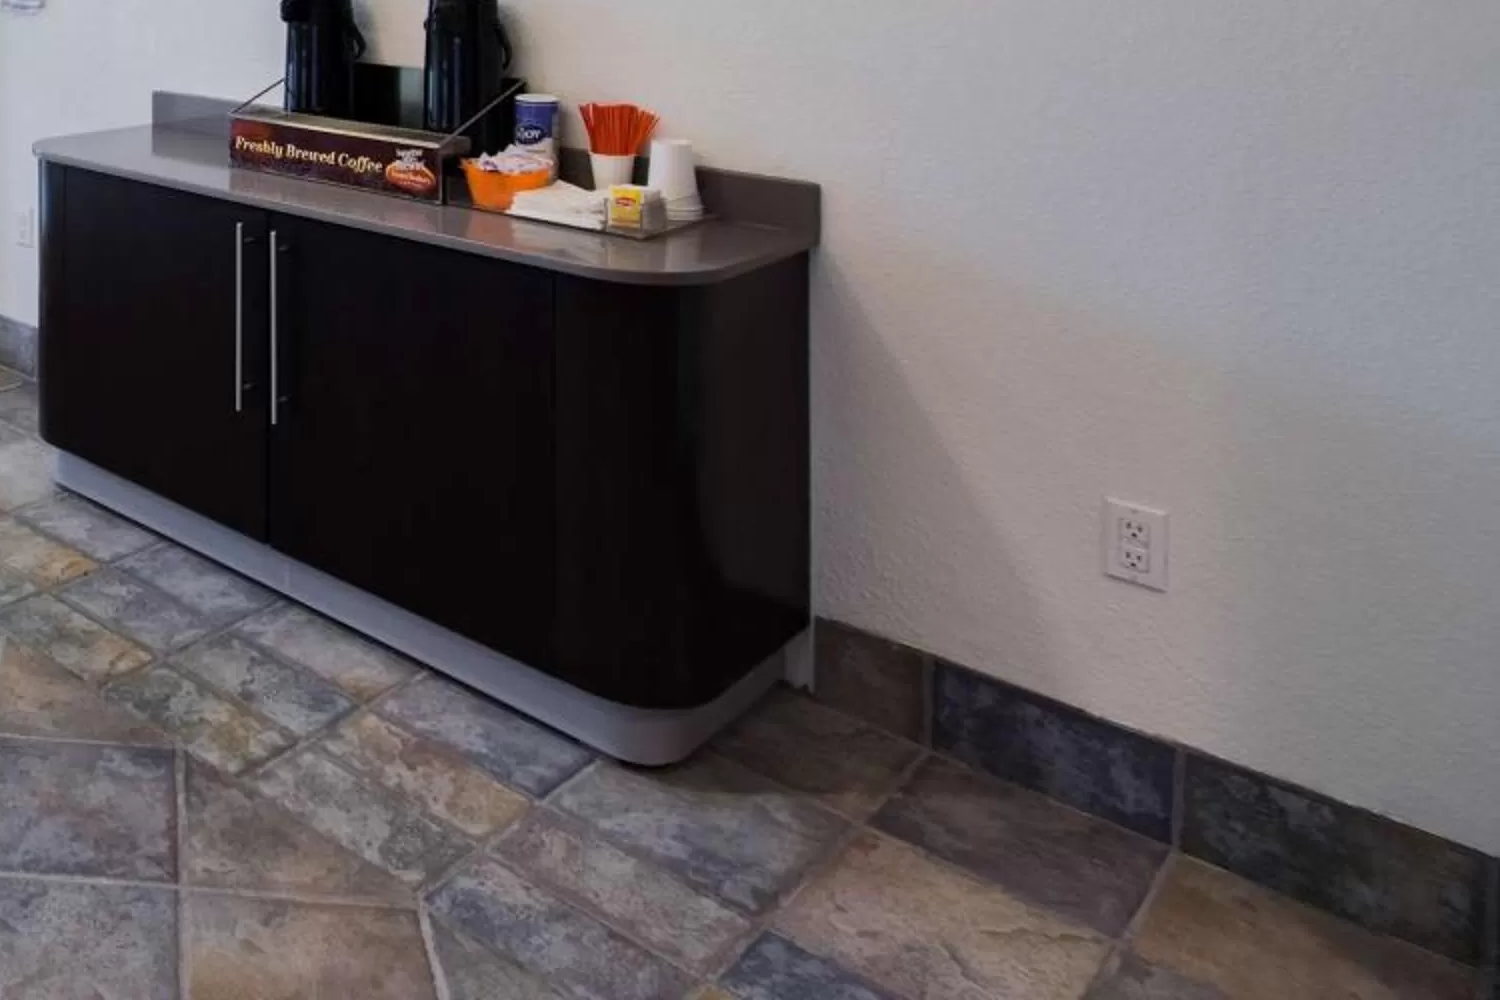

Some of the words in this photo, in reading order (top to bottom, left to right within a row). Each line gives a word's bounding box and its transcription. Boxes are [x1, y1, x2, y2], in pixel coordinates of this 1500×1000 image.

[235, 136, 284, 159] Freshly
[286, 143, 335, 165] Brewed
[337, 153, 383, 173] Coffee
